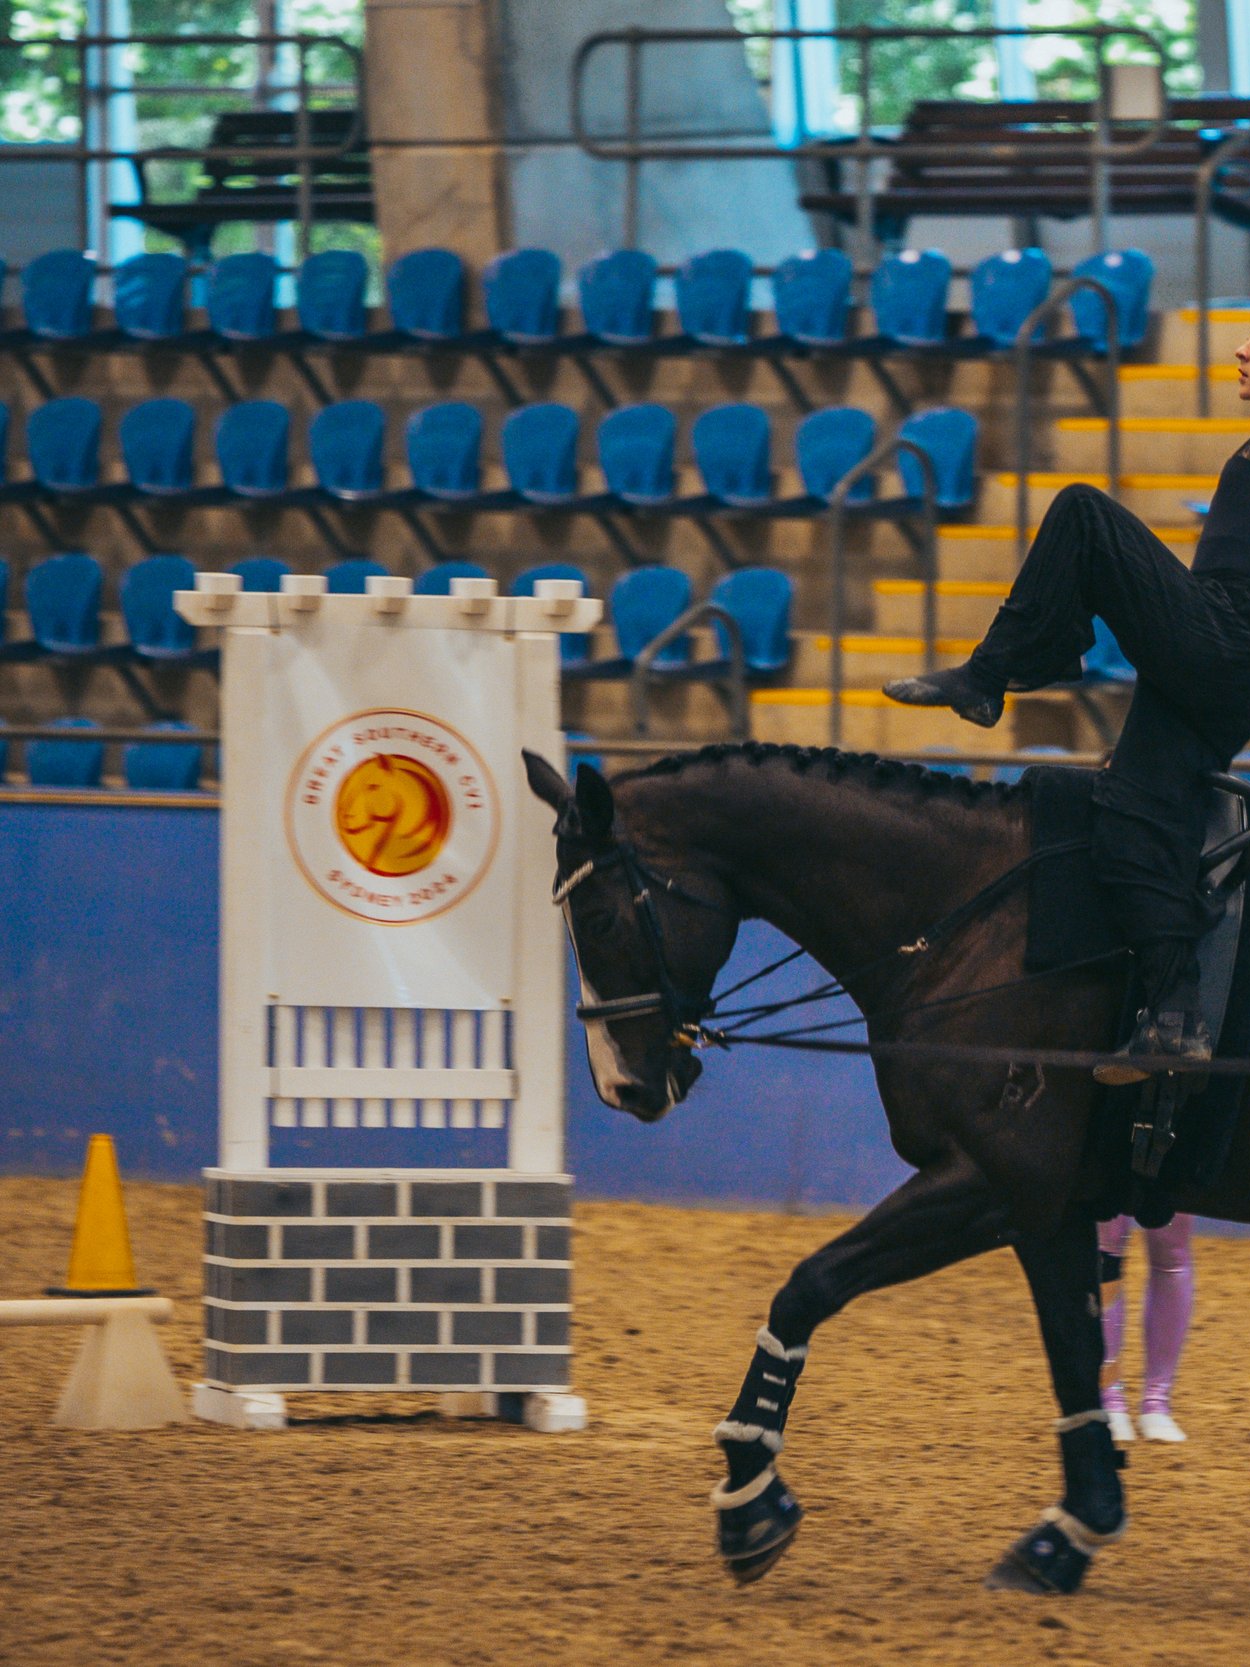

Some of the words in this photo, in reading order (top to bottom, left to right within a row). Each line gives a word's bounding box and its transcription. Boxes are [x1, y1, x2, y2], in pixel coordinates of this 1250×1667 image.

[302, 745, 344, 805] GREAT
[353, 727, 461, 765] SOUTHERN
[326, 869, 402, 907] SYDNEY
[408, 874, 458, 904] 2024
